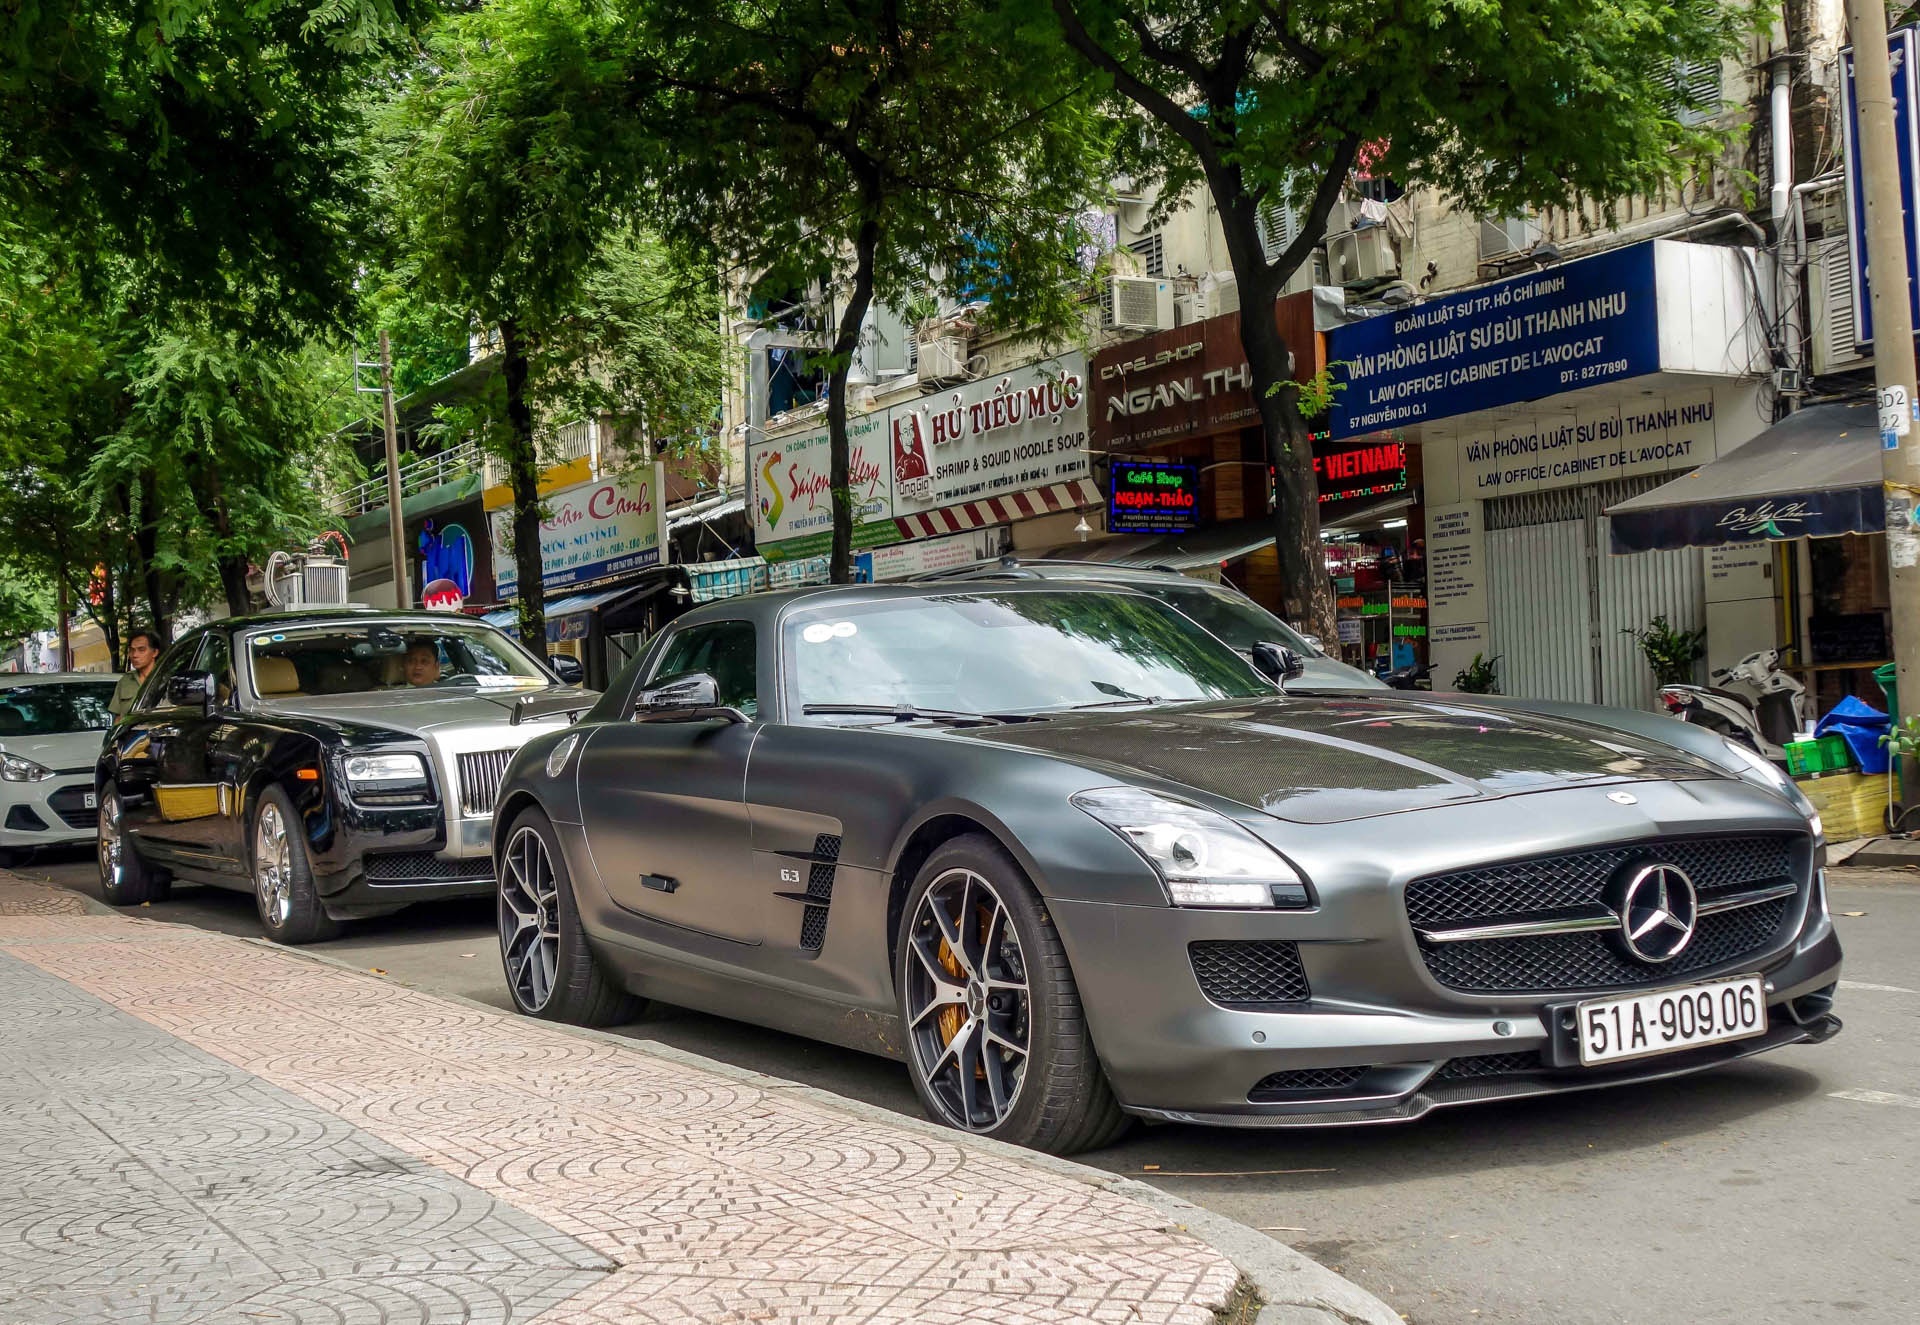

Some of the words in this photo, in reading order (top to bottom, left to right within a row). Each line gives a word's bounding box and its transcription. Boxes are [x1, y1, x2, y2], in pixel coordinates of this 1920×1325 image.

[1395, 311, 1426, 335] ĐOÀN
[1427, 304, 1455, 326] LUẬT
[1457, 301, 1474, 317] SƯ
[1513, 281, 1534, 302] CHÍ
[1535, 277, 1565, 297] MINH
[1348, 353, 1374, 381] VĂN
[1377, 340, 1427, 373] PHÒNG
[1429, 331, 1466, 361] LUẬT
[1470, 322, 1493, 350] SƯ
[1494, 315, 1522, 345] BÙI
[1524, 301, 1585, 337] THANH
[1369, 385, 1396, 405] LAW
[1512, 354, 1530, 373] DE
[1581, 358, 1627, 380] 8277890
[931, 392, 965, 447] HỦ
[969, 377, 1026, 436] TIẾU
[1349, 416, 1360, 430] 57
[1398, 405, 1411, 418] DU
[1412, 403, 1427, 416] Q.1
[1466, 440, 1490, 463] VĂN
[1493, 432, 1539, 459] PHÒNG
[1541, 426, 1574, 451] LUẬT
[1577, 421, 1597, 443] SƯ
[1599, 417, 1623, 439] BÙI
[1627, 409, 1677, 435] THANH
[936, 459, 970, 480] SHRIMP
[972, 458, 979, 471] &
[981, 449, 1011, 470] SQUID
[1013, 439, 1054, 464] NOODLE
[1057, 431, 1085, 451] SOUP
[1127, 470, 1153, 484] Café
[1156, 471, 1182, 488] Shop
[1325, 443, 1400, 480] VIETNAM
[1477, 471, 1502, 488] LAW
[1609, 451, 1627, 466] DE
[1588, 984, 1757, 1055] 51A-909.06
